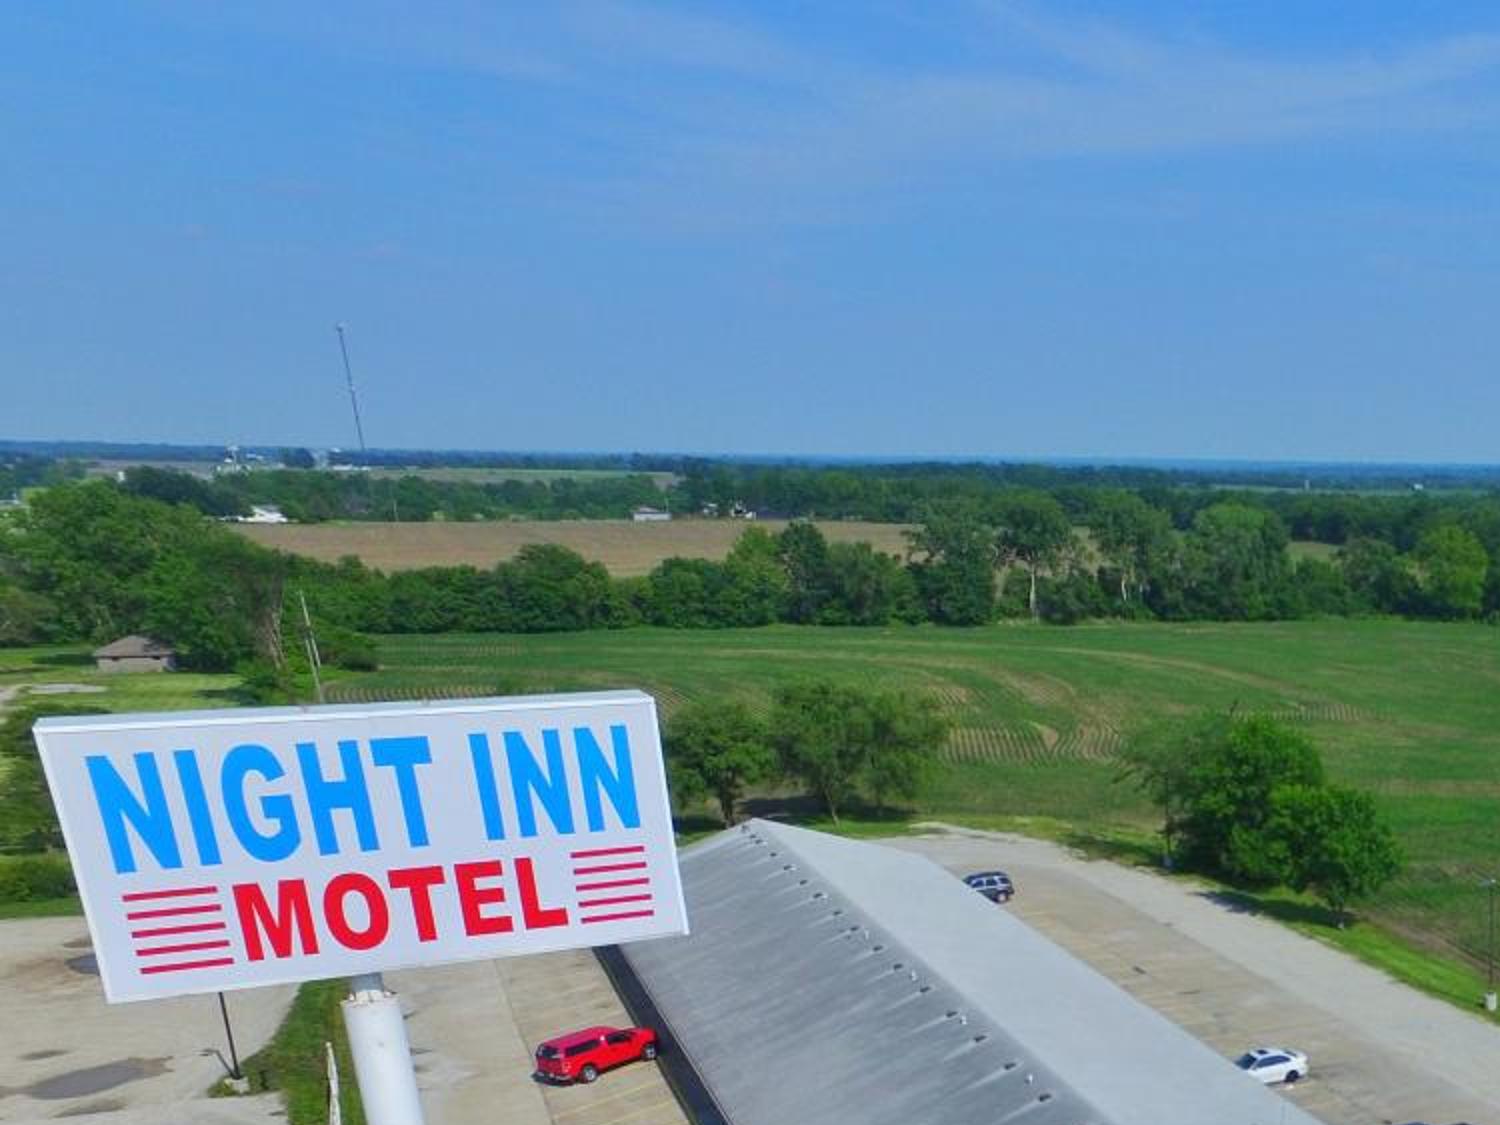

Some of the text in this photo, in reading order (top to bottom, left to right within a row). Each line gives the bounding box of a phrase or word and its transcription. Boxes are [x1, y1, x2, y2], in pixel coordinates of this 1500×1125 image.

[85, 723, 642, 875] NIGHT INN
[232, 857, 569, 961] MOTEL
